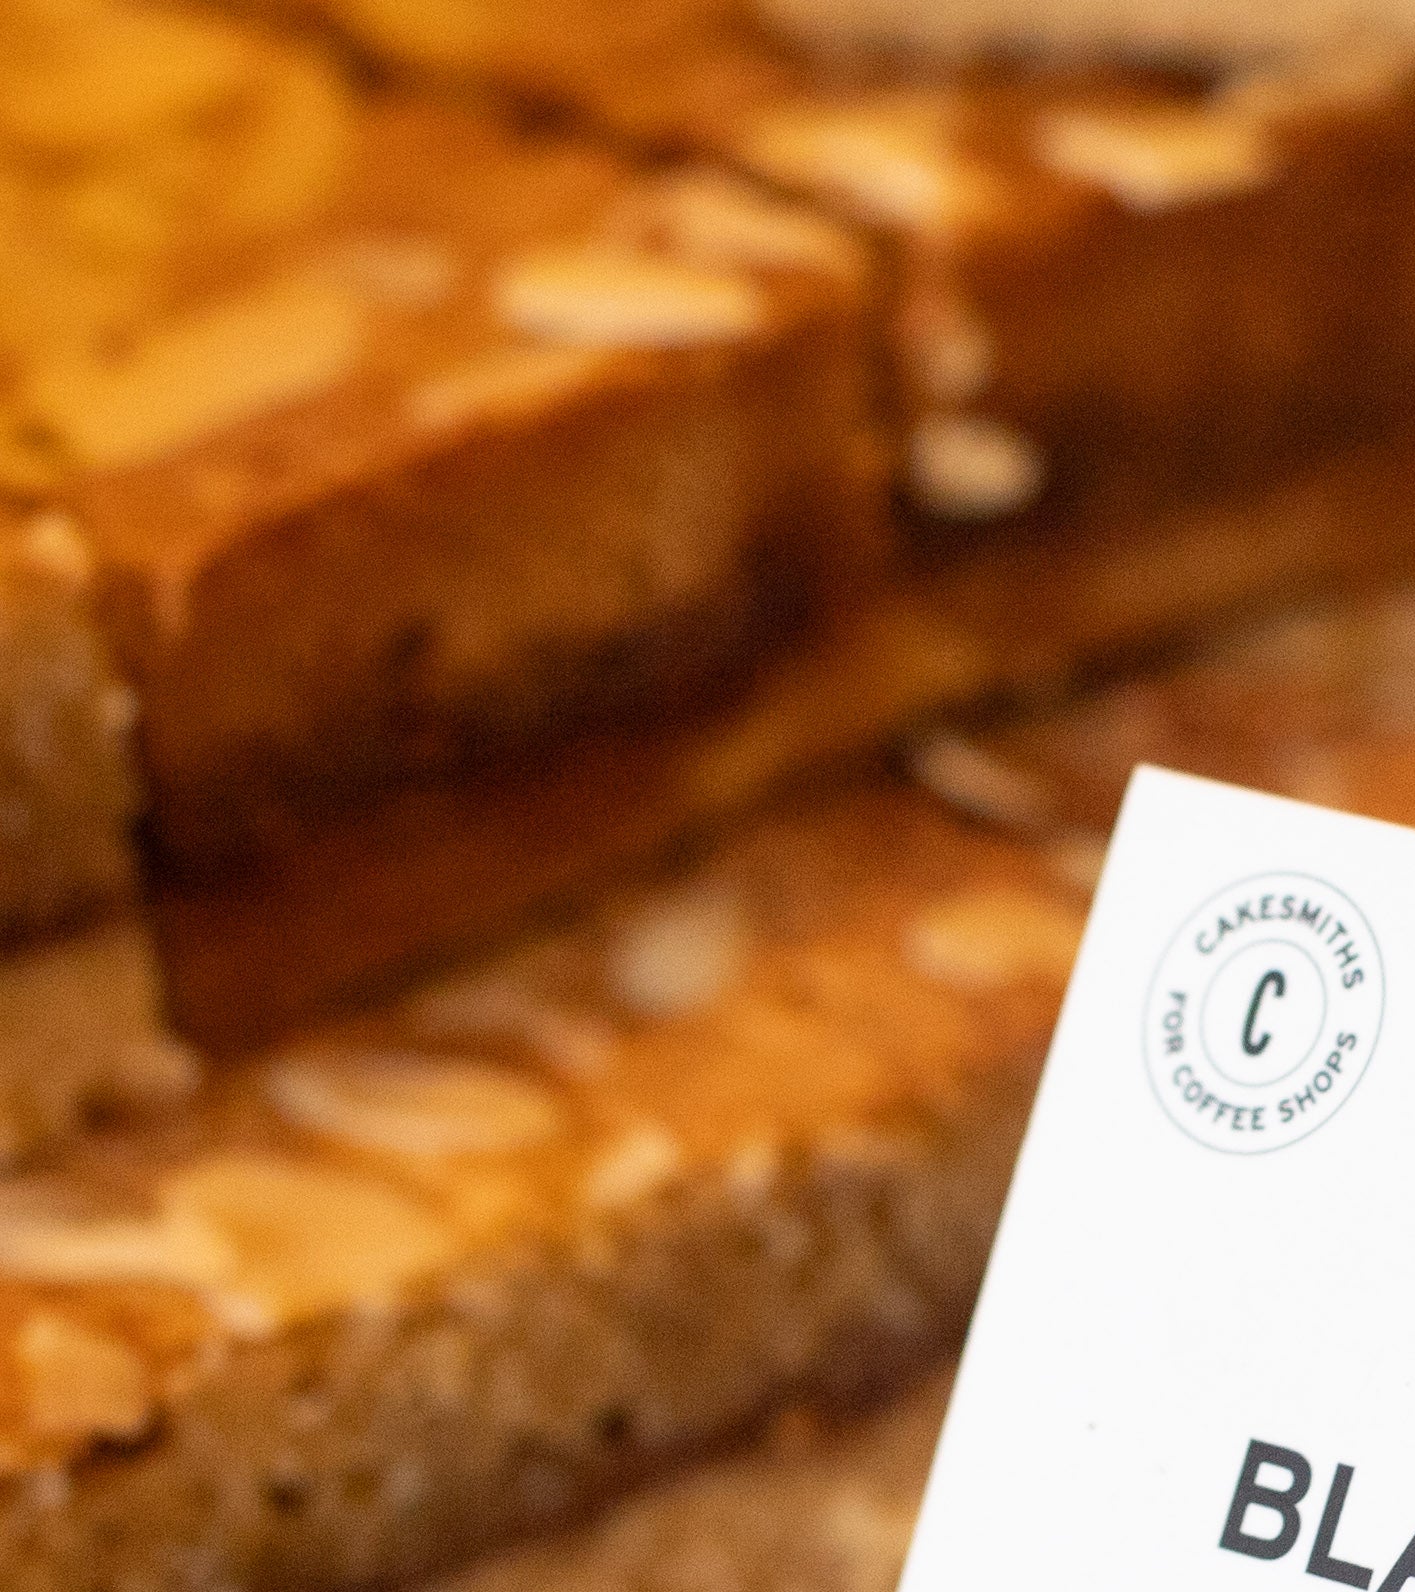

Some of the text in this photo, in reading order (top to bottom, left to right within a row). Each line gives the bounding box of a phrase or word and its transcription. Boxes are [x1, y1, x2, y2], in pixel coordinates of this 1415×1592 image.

[1195, 895, 1364, 990] CAKESMITHS
[1241, 968, 1286, 1056] C
[1163, 990, 1357, 1131] FOR COFFEE SHOPS
